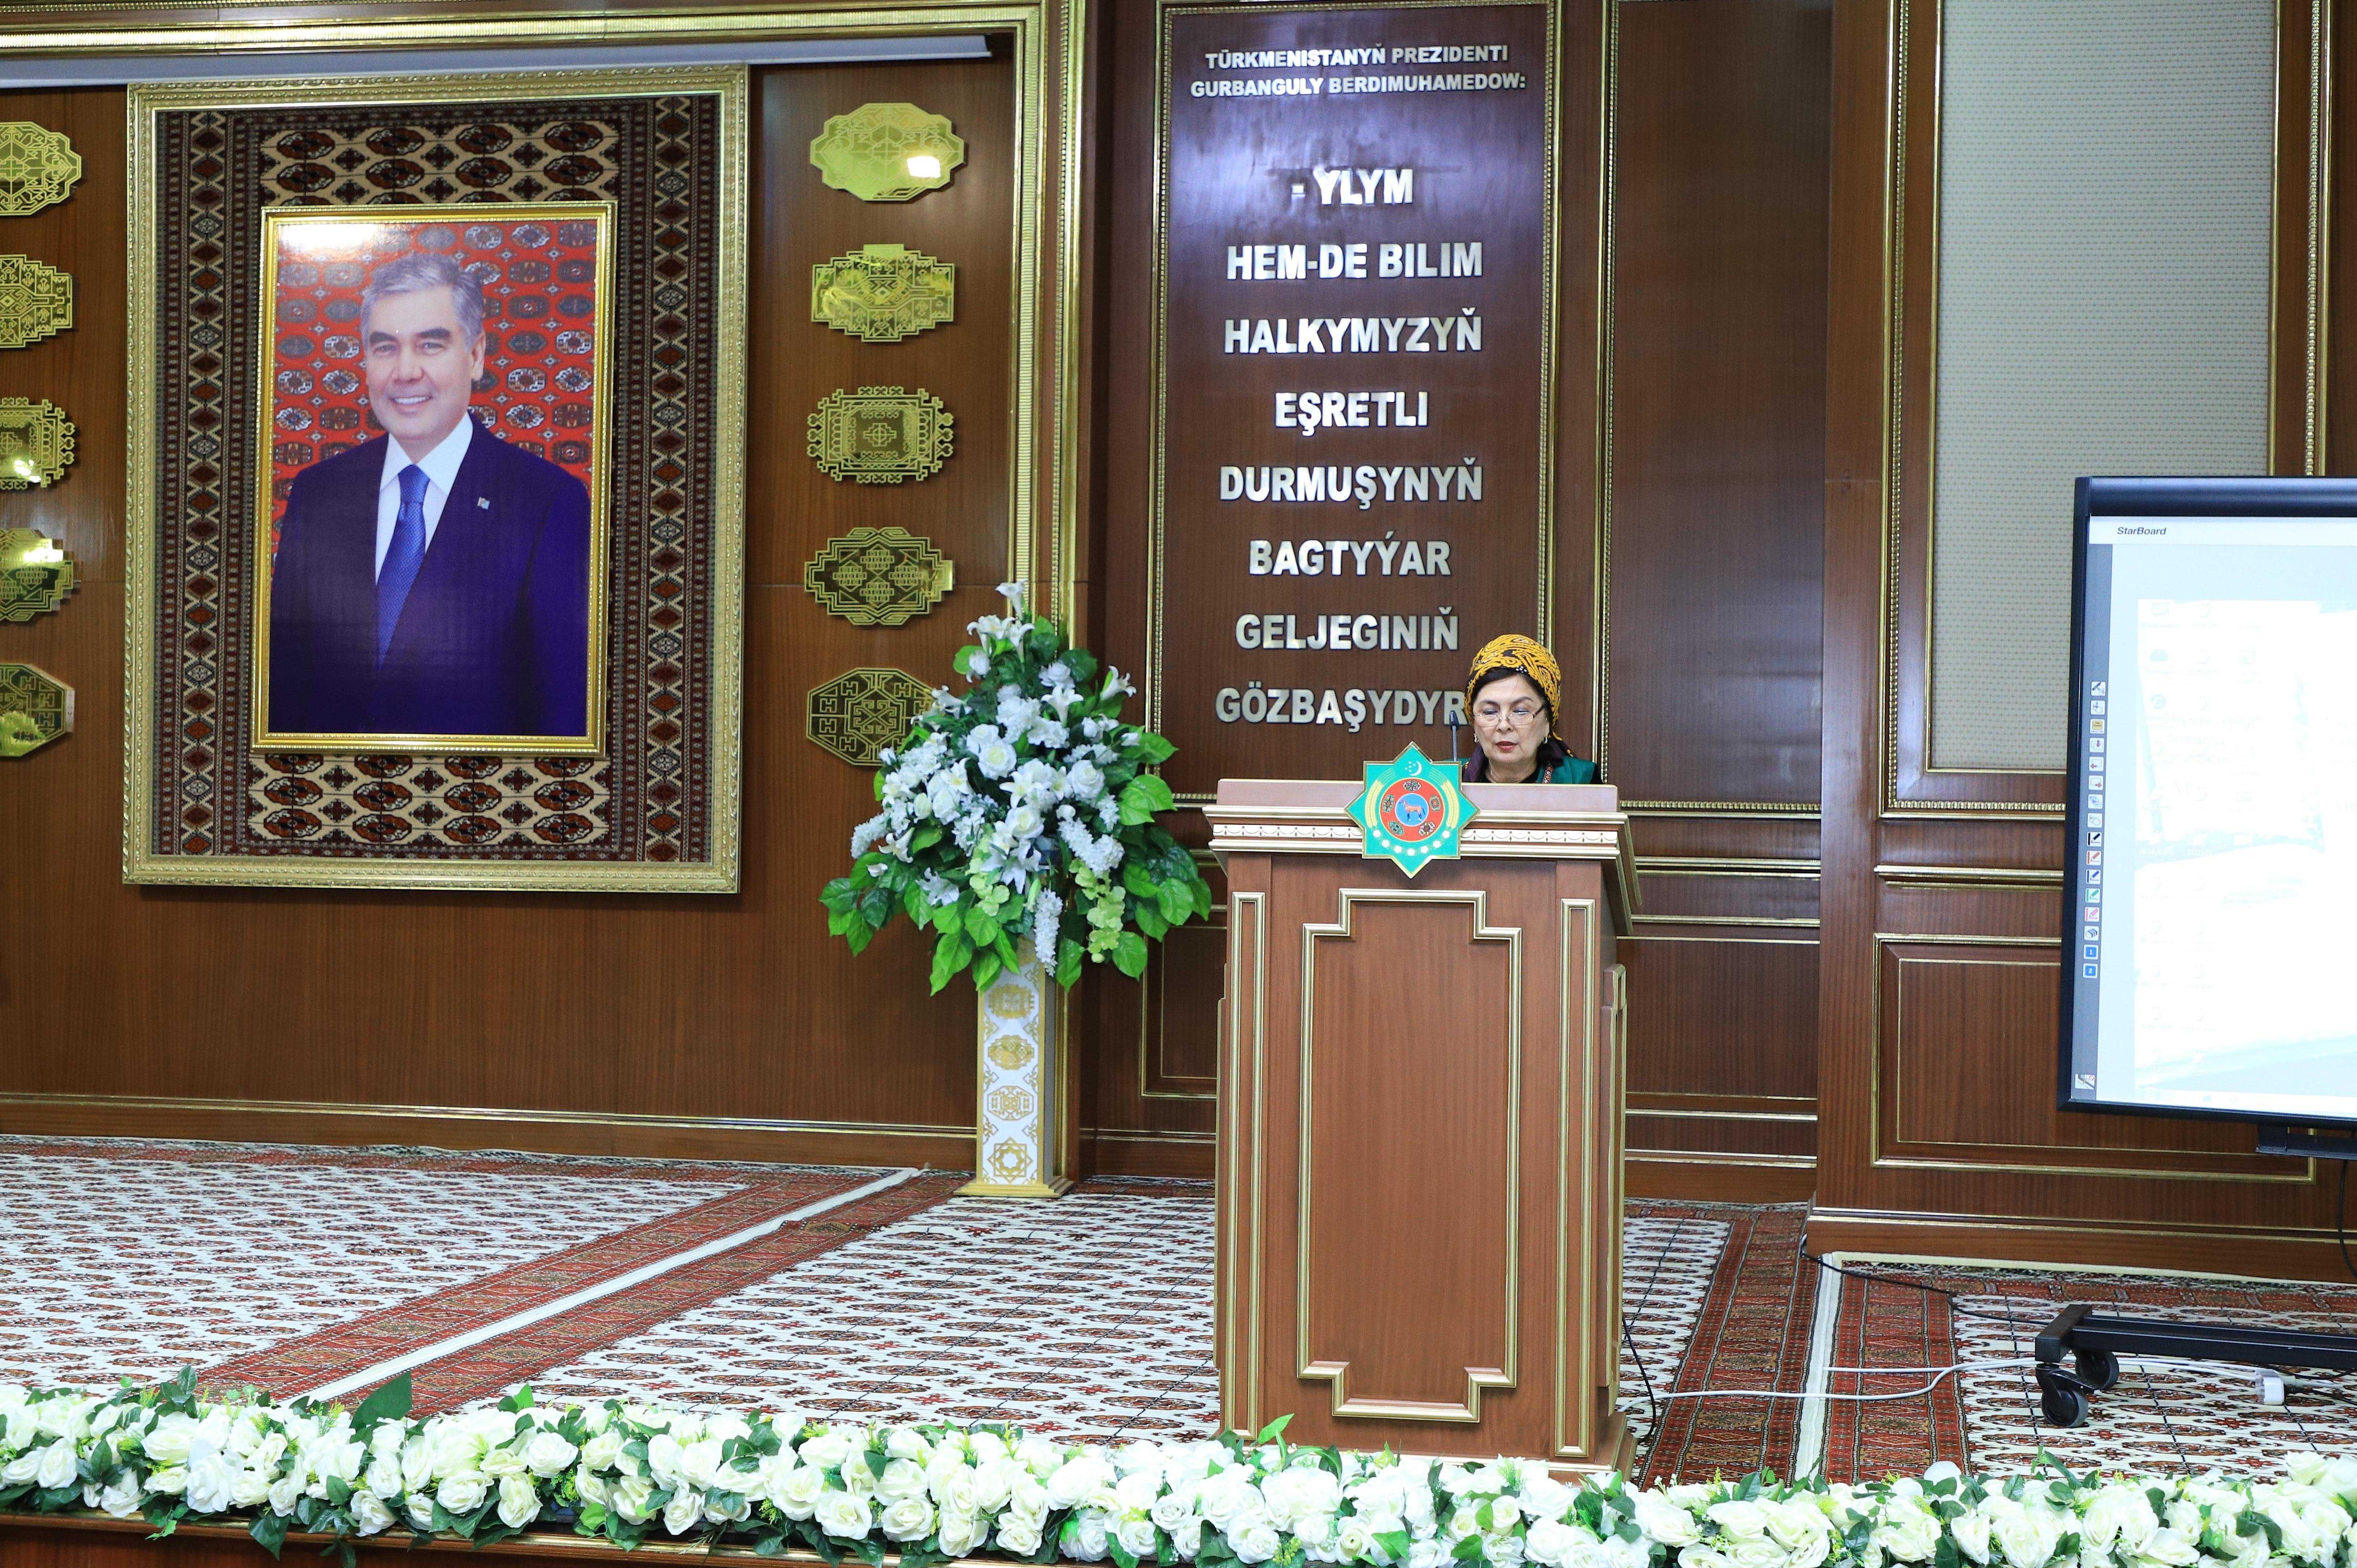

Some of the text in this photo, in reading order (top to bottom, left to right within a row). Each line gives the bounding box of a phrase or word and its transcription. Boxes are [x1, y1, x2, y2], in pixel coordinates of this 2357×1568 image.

[1205, 43, 1508, 69] TÜRKMENISTANYŇ PREZIDENTI
[1191, 72, 1527, 98] GURBANGULY BERDIMUHAMEDOW:
[1313, 169, 1413, 205] YLYM
[1227, 242, 1483, 280] HEM-DE BILIM
[1224, 307, 1482, 353] HALKYMYZYŇ
[1275, 391, 1428, 437] EŞRETLI
[1220, 457, 1482, 510] DURMUŞYNYŇ
[2117, 527, 2167, 535] StarBoard
[1249, 531, 1452, 575] BAGTYÝAR
[1235, 607, 1458, 650] GELJEGINIŇ
[1215, 681, 1469, 732] GÖZBAŞYDYR
